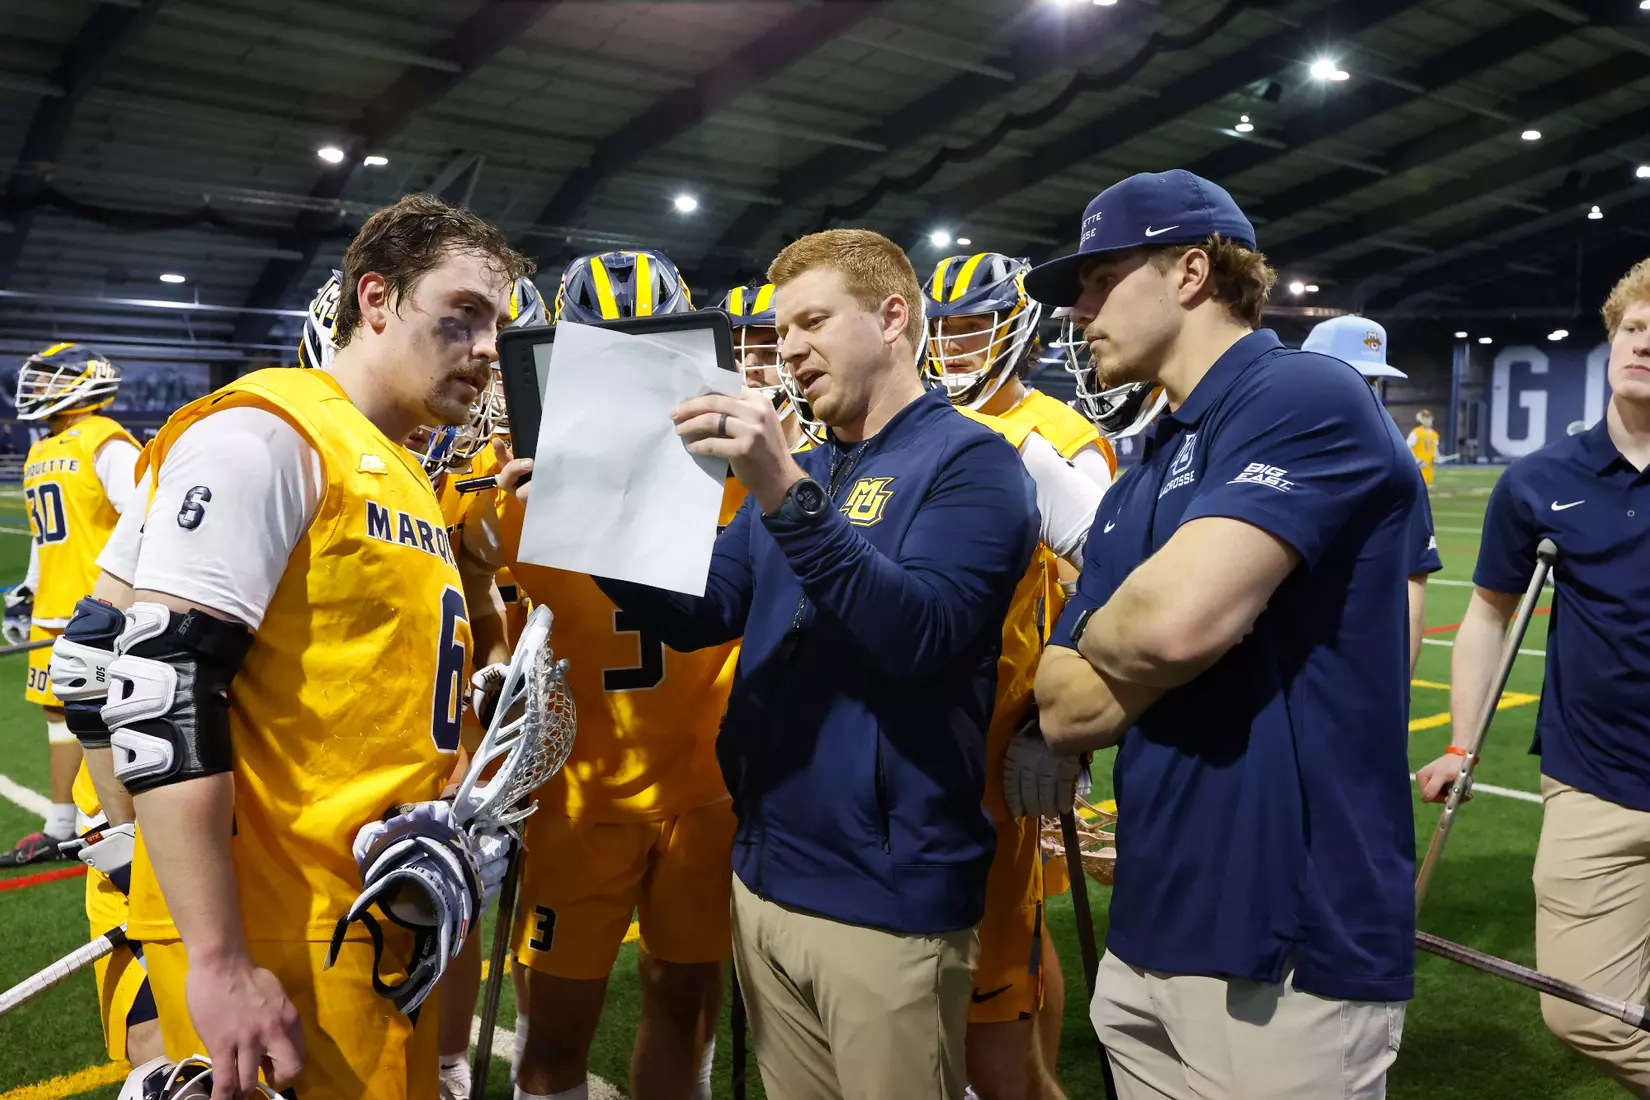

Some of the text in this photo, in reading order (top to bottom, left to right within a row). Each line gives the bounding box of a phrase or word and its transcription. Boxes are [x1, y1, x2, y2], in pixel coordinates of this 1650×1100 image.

[1234, 473, 1294, 490] EAST
[1244, 462, 1287, 477] BIG
[177, 485, 212, 531] 6
[843, 478, 889, 523] MU
[178, 613, 195, 635] STX
[28, 667, 48, 692] 30
[95, 665, 106, 683] 500
[431, 585, 469, 754] 6
[528, 904, 556, 953] 3
